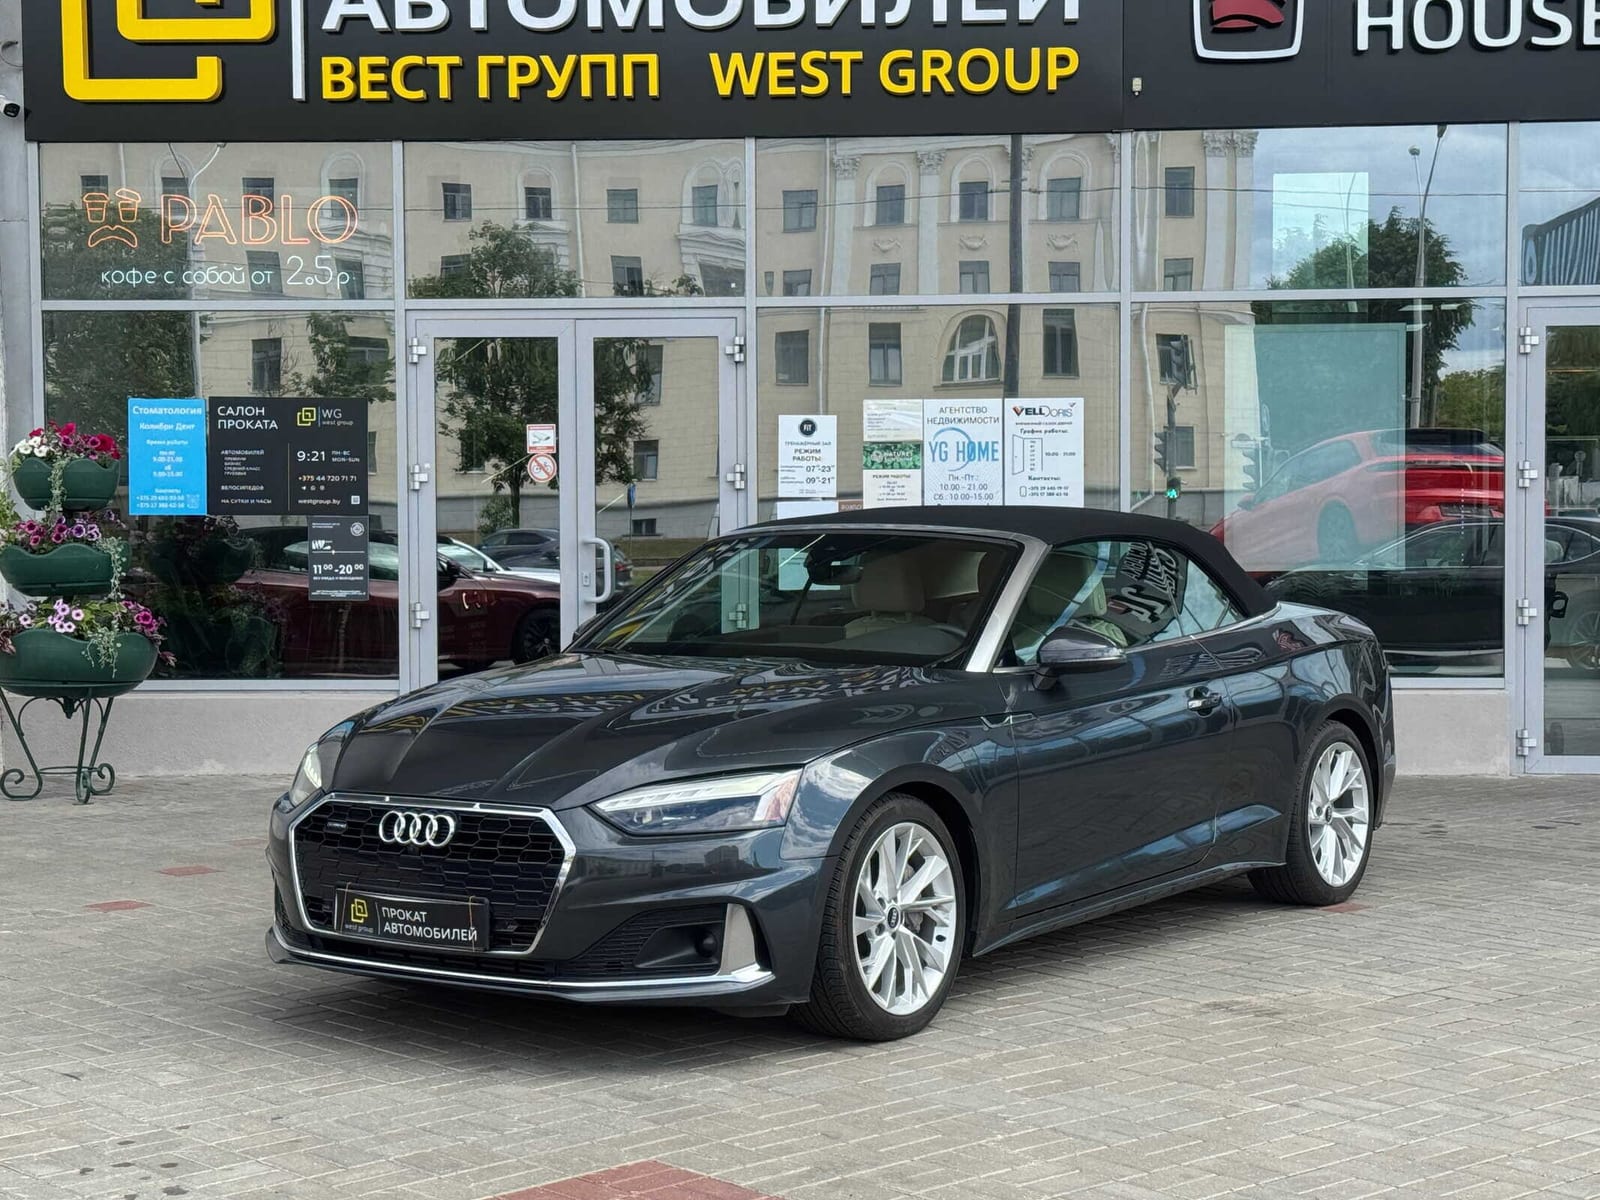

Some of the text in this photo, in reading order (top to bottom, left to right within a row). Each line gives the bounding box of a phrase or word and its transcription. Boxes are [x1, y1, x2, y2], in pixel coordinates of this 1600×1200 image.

[321, 53, 660, 101] ВЕСТ ГРУПП
[709, 47, 1081, 98] WEST GROUP
[161, 194, 358, 245] PABLO
[101, 267, 157, 287] кофе
[163, 270, 175, 284] с
[182, 265, 245, 285] собой
[251, 270, 274, 284] от
[133, 406, 202, 416] Стоматология
[217, 406, 265, 417] САЛОН
[322, 408, 342, 419] WG
[939, 406, 988, 414] АГЕНТСТВО
[218, 419, 278, 430] ПРОКАТА
[927, 417, 999, 425] НЕДВИЖИМОСТИ
[297, 450, 325, 462] 9:21
[928, 441, 948, 462] YG
[382, 906, 428, 923] ПРОКАТ
[383, 921, 477, 942] АВТОМОБИЛЕЙ
